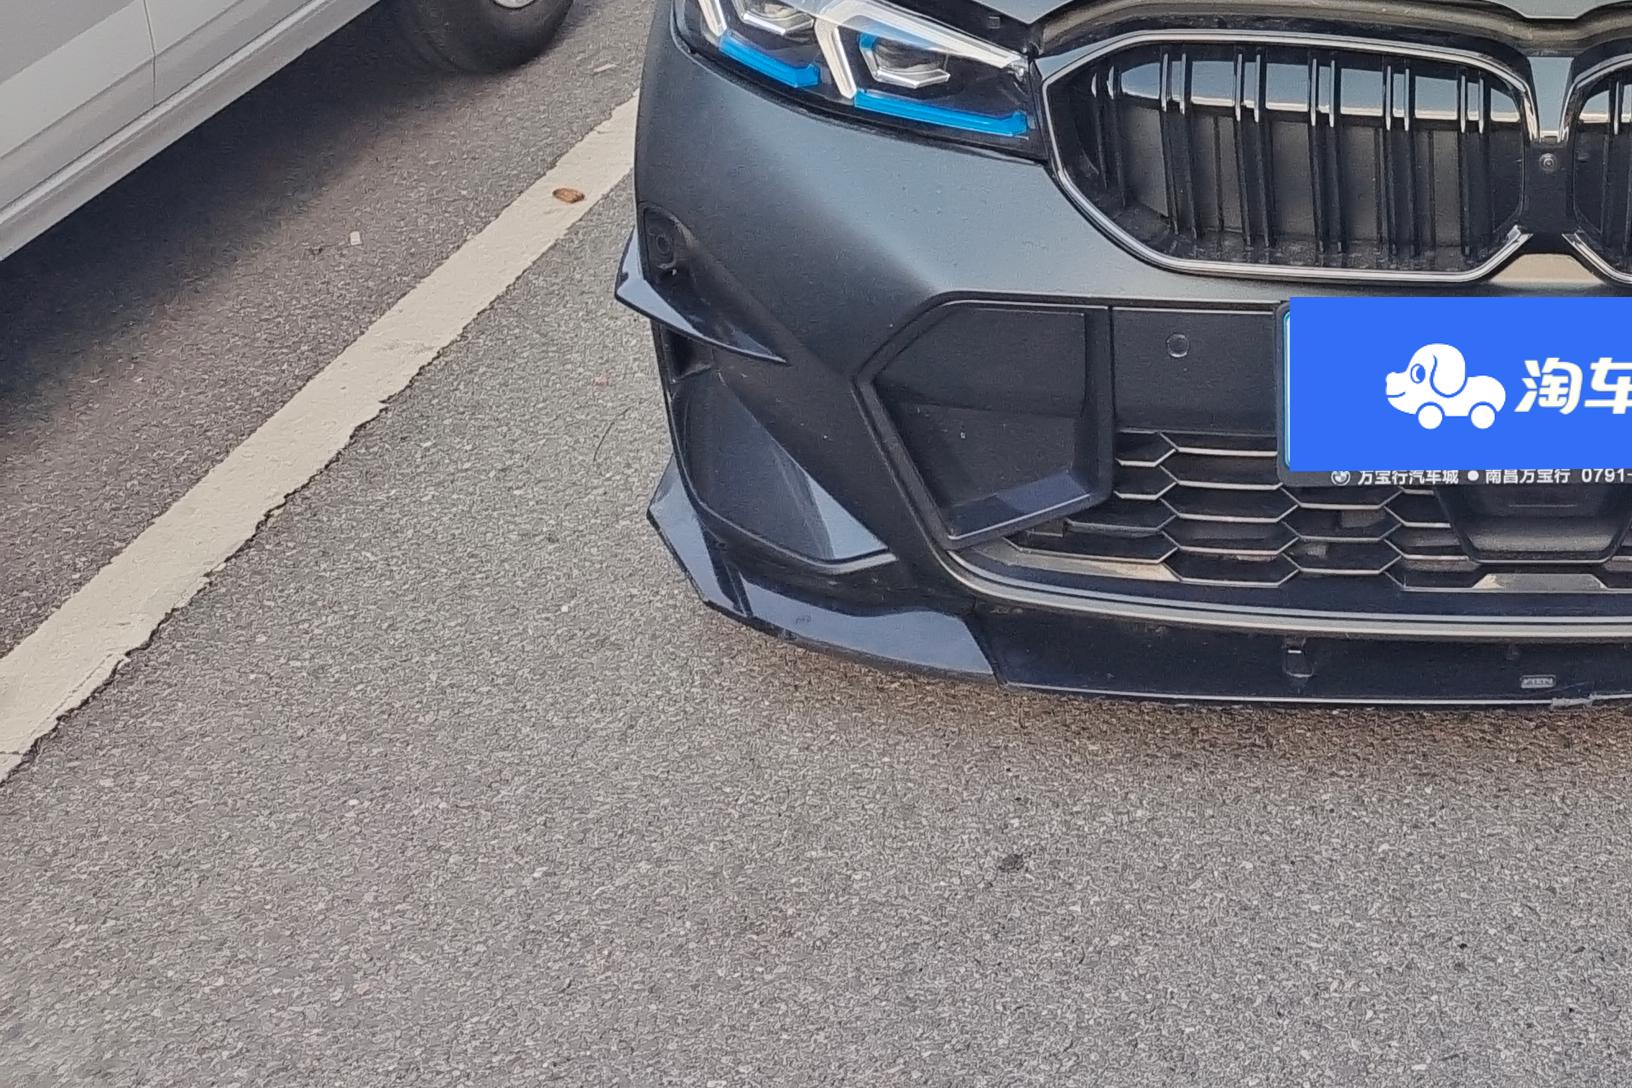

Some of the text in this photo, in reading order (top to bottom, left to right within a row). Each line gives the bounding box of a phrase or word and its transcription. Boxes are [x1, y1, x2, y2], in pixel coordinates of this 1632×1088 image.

[1357, 469, 1459, 485] 万宝行汽车城
[1485, 468, 1571, 485] 南昌万宝行
